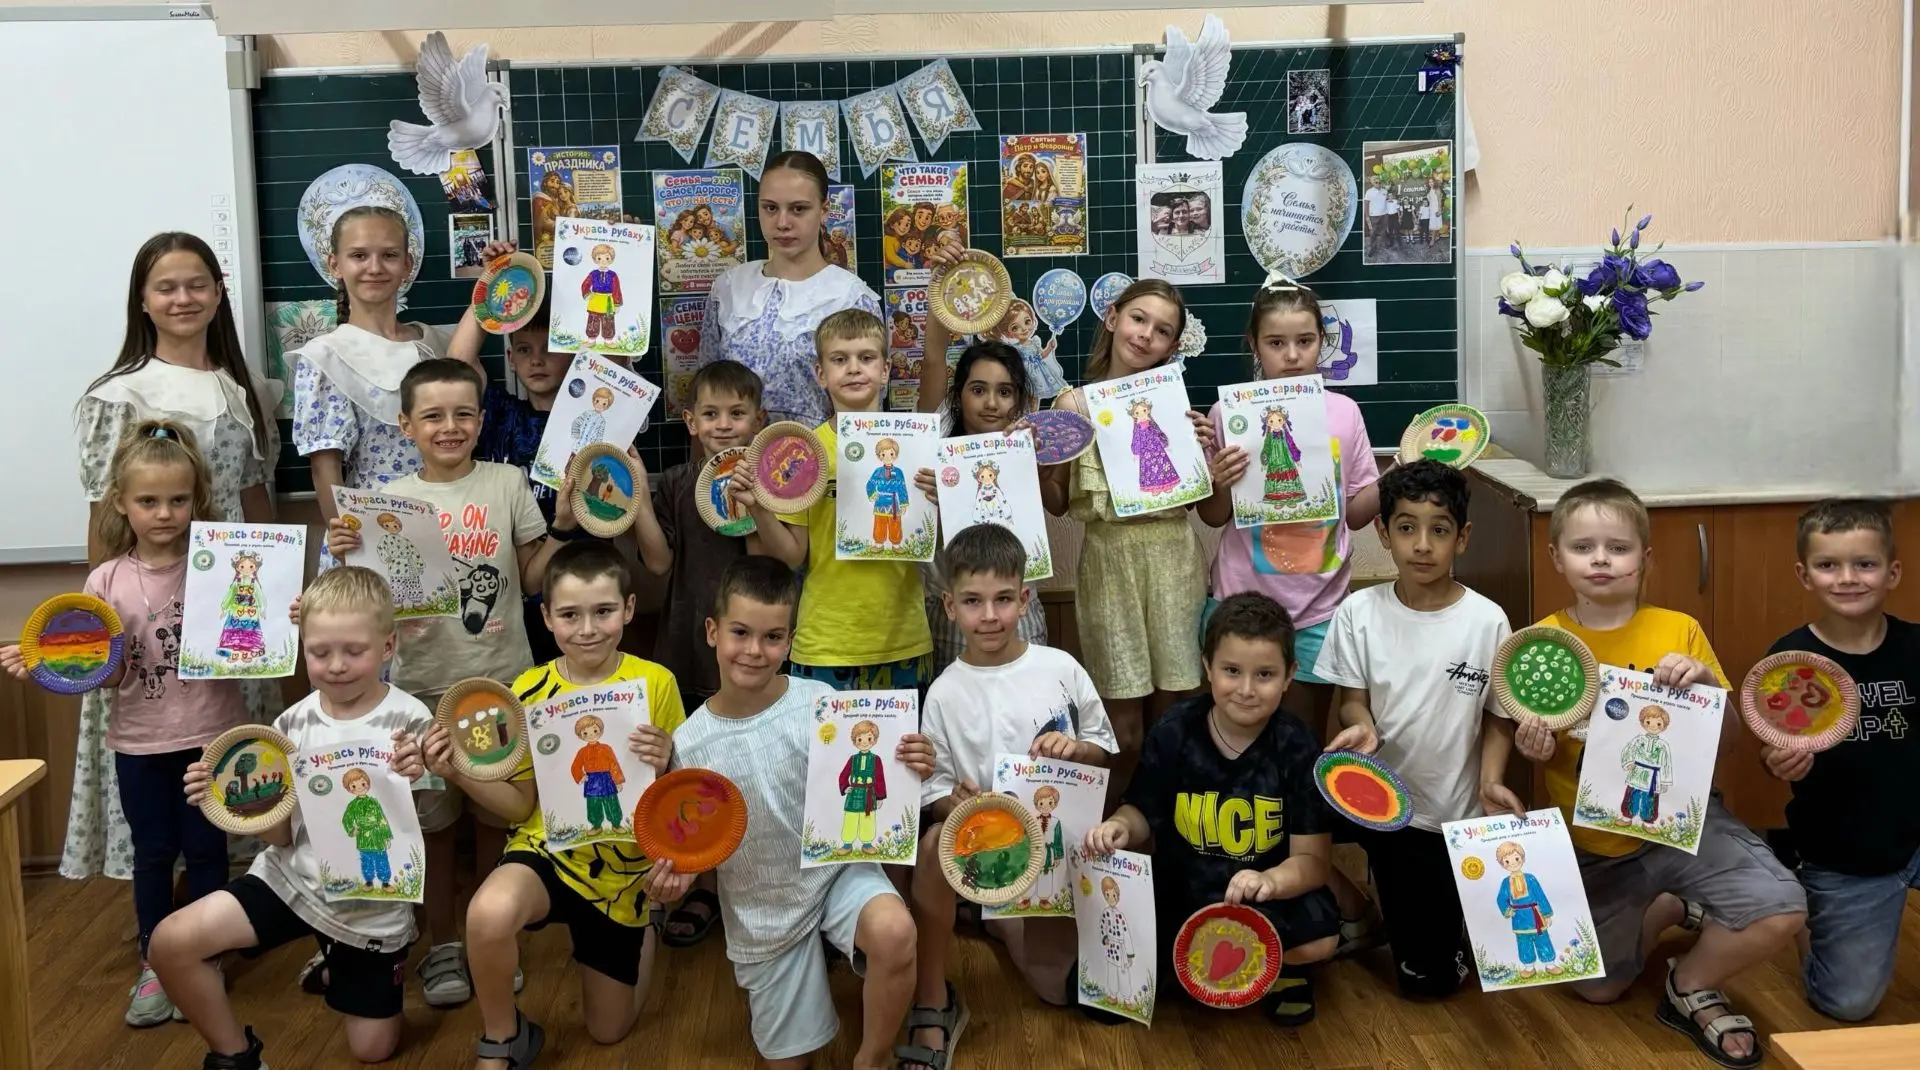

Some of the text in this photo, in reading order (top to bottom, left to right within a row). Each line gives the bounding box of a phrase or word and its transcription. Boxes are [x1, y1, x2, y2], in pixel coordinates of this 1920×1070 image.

[668, 86, 951, 152] СЕМЬЯ
[1030, 136, 1056, 144] Святые
[544, 158, 606, 172] ПРАЗДНИКА
[898, 166, 949, 176] ЧТО ТАКОЕ
[664, 176, 701, 188] Семья
[711, 176, 732, 185] это
[900, 175, 950, 187] СЕМЬЯ?
[694, 185, 739, 198] дорогое,
[665, 199, 681, 207] что
[693, 197, 710, 205] нас
[711, 196, 737, 206] есть!
[1281, 191, 1317, 212] Семья
[1270, 207, 1325, 226] начинается
[572, 224, 608, 236] Укрась
[611, 227, 644, 241] рубаху
[907, 290, 928, 301] РО
[1048, 284, 1056, 295] 8
[1104, 288, 1110, 298] 8
[905, 303, 913, 313] В
[588, 358, 617, 380] Укрась
[618, 375, 648, 399] рубаху
[1097, 382, 1132, 399] Укрась
[1134, 373, 1173, 387] сарафан
[1232, 386, 1270, 402] Укрась
[1272, 383, 1314, 395] сарафан
[854, 418, 929, 433] Укрась рубаху
[946, 441, 981, 457] Укрась
[983, 438, 1025, 450] сарафан
[349, 494, 388, 505] Укрась
[390, 499, 426, 513] рубаху
[462, 503, 489, 531] ON
[207, 529, 247, 542] Укрась
[250, 530, 296, 545] сарафан
[444, 530, 500, 560] AYING
[1618, 676, 1664, 693] Укрась
[1667, 686, 1711, 708] рубаху
[1857, 680, 1916, 708] VEL
[545, 694, 589, 717] Укрась
[593, 690, 635, 705] рубаху
[831, 696, 910, 713] Укрась рубаху
[310, 748, 354, 767] Укрась
[358, 746, 393, 764] рубаху
[1013, 763, 1053, 777] Укрась
[1057, 766, 1096, 784] рубаху
[1174, 791, 1284, 857] NICE
[1463, 822, 1506, 839] Укрась
[1510, 818, 1550, 831] рубаху
[1112, 856, 1142, 876] рубаху
